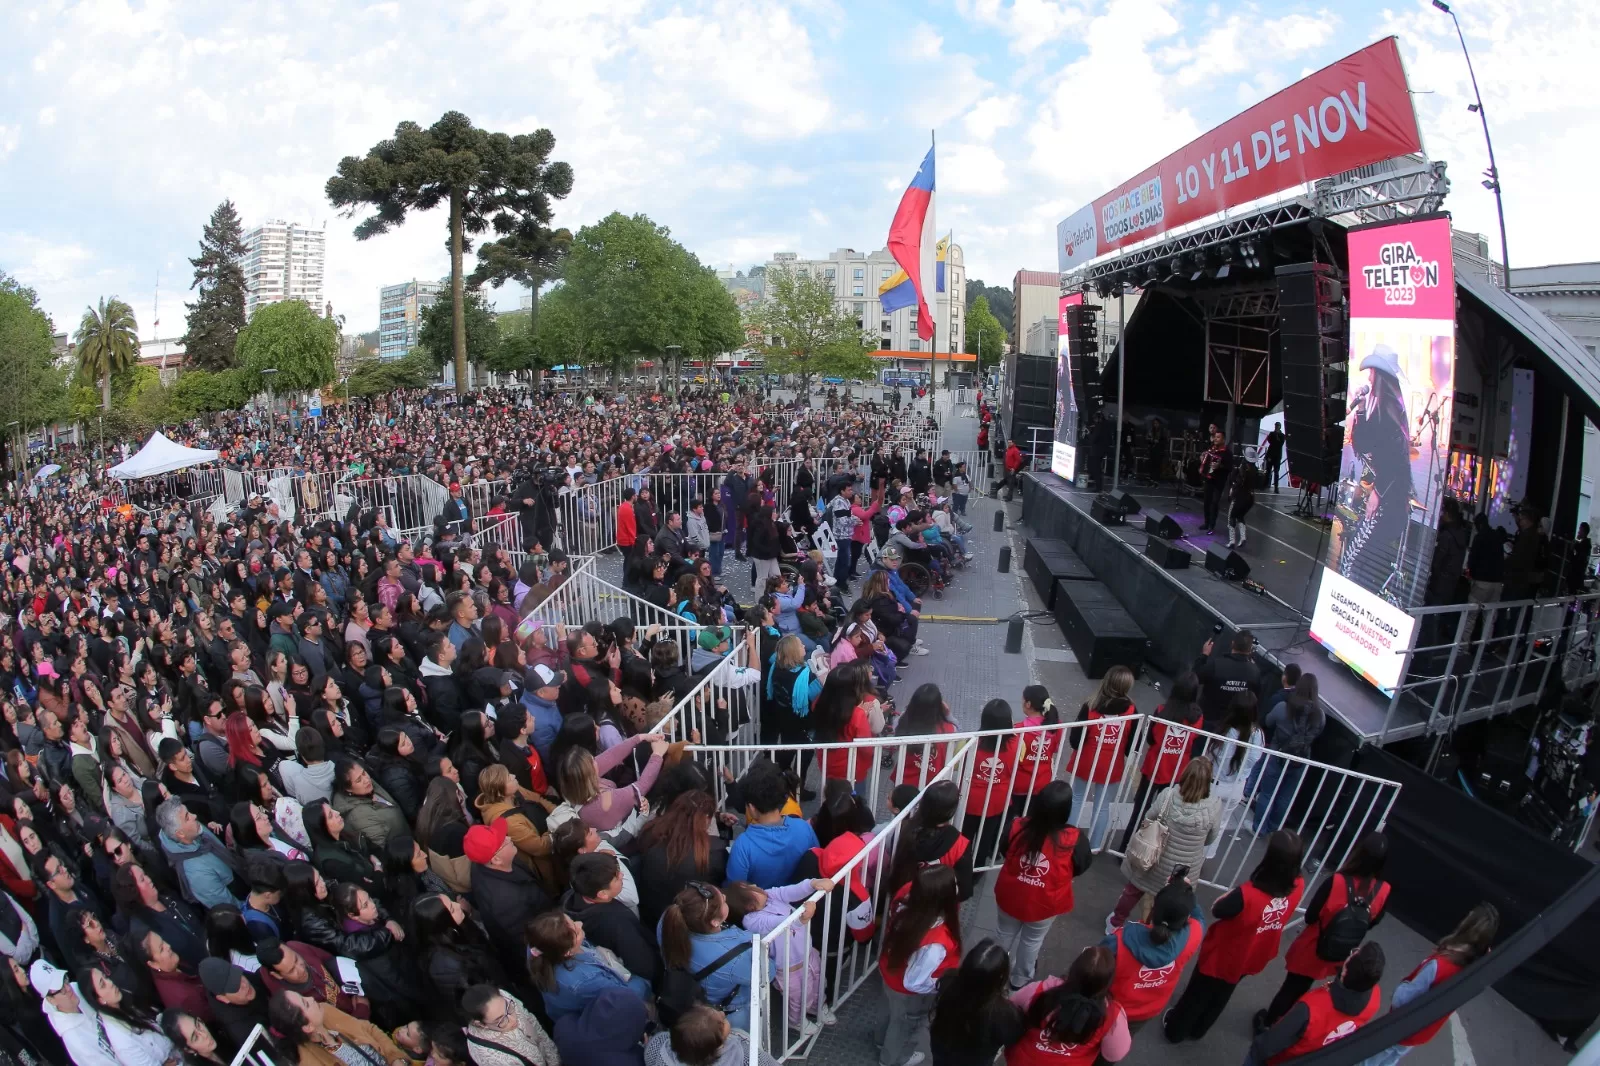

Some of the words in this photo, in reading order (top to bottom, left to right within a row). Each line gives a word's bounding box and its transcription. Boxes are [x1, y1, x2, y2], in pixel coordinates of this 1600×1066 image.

[1175, 165, 1200, 204] 10
[1202, 153, 1215, 190] Y
[1221, 141, 1249, 184] 11
[1251, 120, 1290, 170] DE
[1293, 82, 1367, 154] NOV
[1103, 202, 1119, 223] NOS
[1119, 191, 1141, 214] HACE
[1142, 179, 1161, 205] BIEN
[1105, 217, 1128, 241] TODOS
[1381, 244, 1416, 265] GIRA
[1386, 287, 1414, 302] 2023
[1331, 589, 1360, 614] LLEGAMOS
[1360, 608, 1365, 616] A
[1366, 610, 1375, 623] TU
[1375, 617, 1399, 638] CIUDAD
[1331, 603, 1355, 625] GRACIAS
[1354, 619, 1360, 628] A
[1360, 622, 1392, 649] NUESTROS
[1335, 620, 1379, 657] AUSPICIADORES
